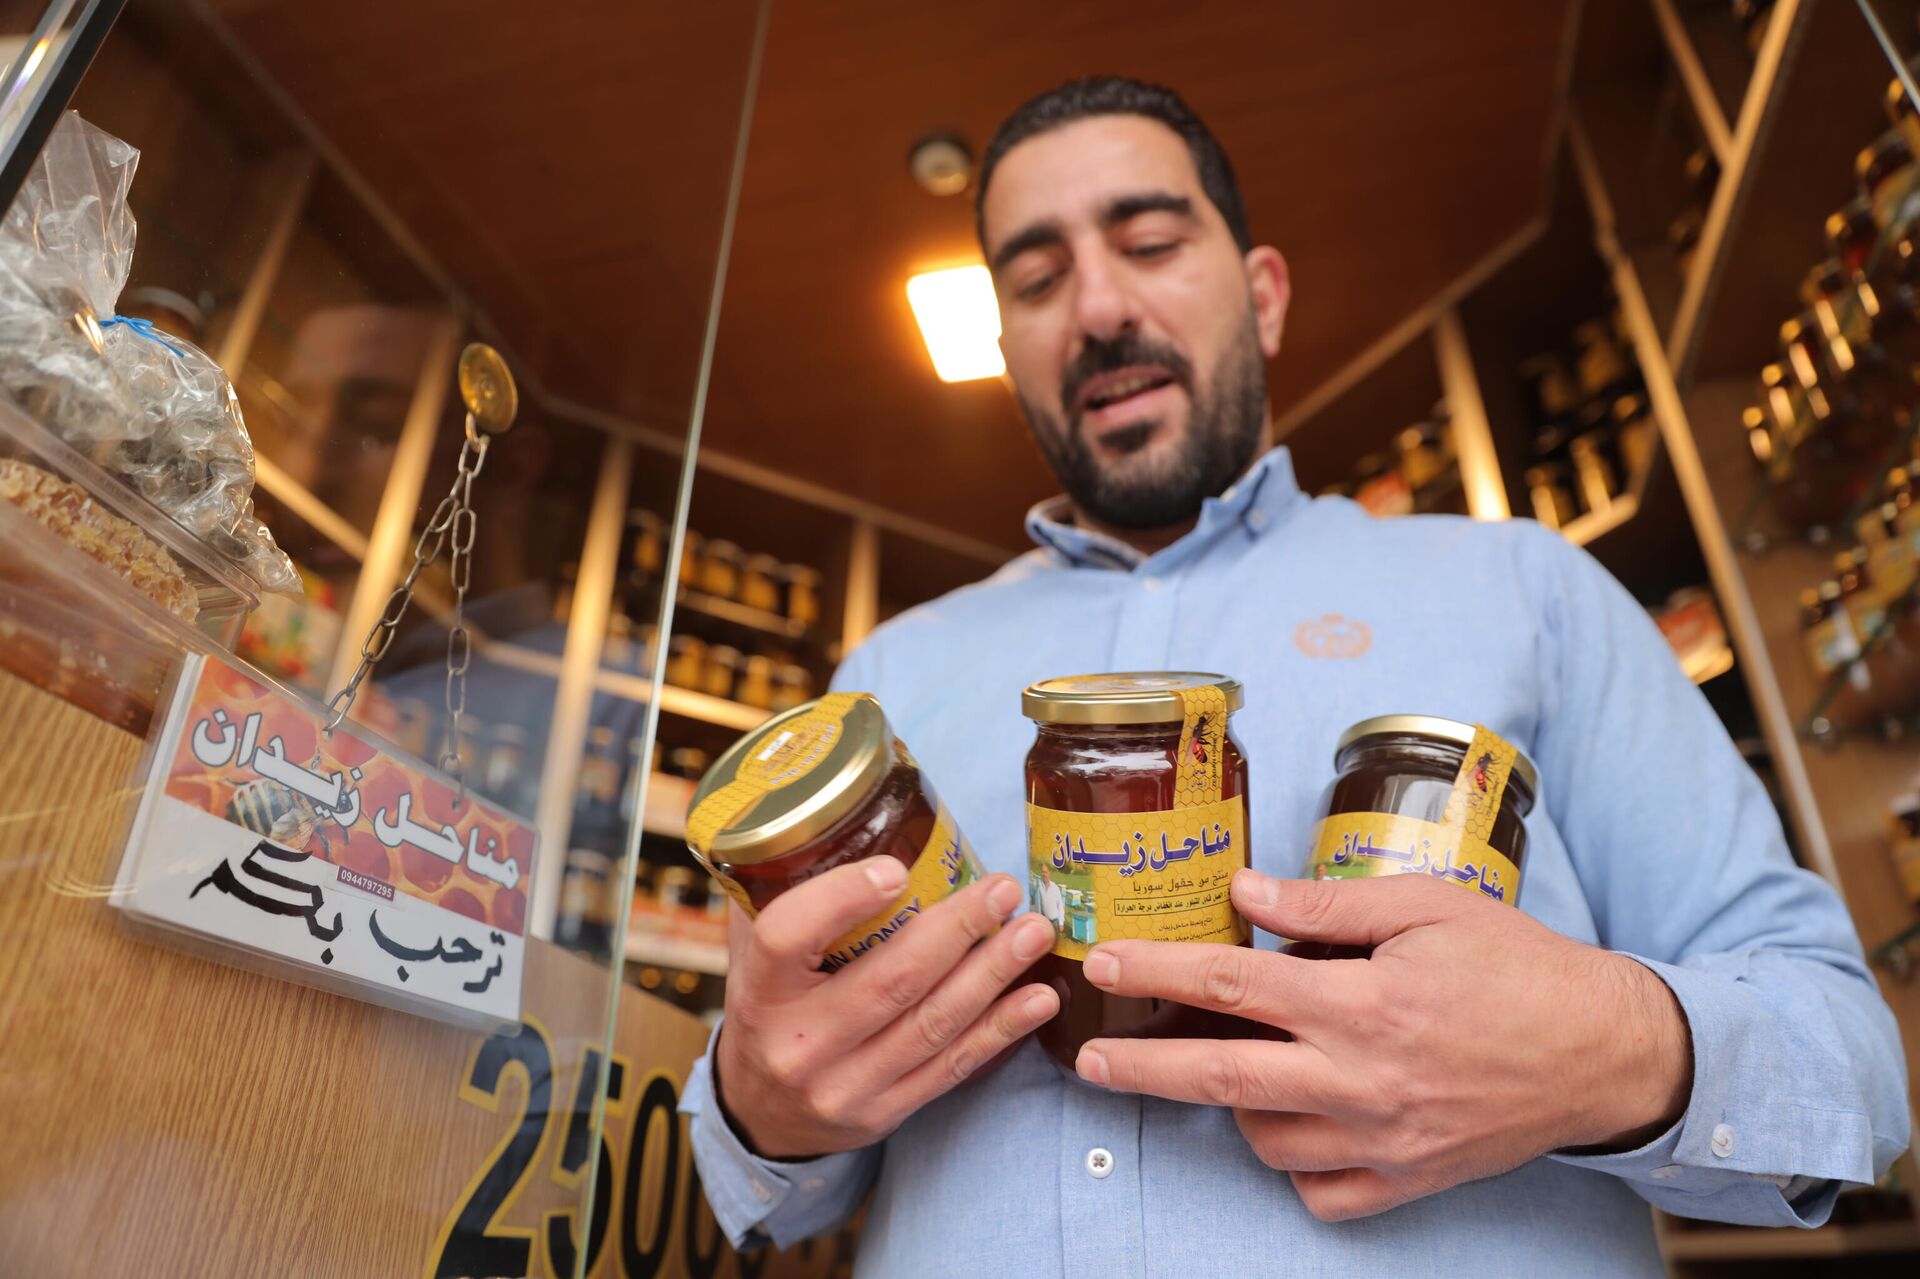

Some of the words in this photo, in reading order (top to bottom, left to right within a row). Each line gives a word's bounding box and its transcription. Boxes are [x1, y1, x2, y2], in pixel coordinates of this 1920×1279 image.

[191, 707, 365, 828] زيدان
[373, 791, 521, 891] مناحل
[1052, 831, 1148, 876] زيدان
[1149, 823, 1232, 871] مناحل
[1333, 831, 1431, 873] زيدان
[341, 869, 393, 898] 0944797295
[1133, 881, 1163, 894] سوريا
[1168, 878, 1194, 892] حقول
[1198, 877, 1210, 888] من
[1431, 848, 1504, 901] مناحل
[189, 838, 343, 965] بكم
[368, 908, 506, 993] ترحب
